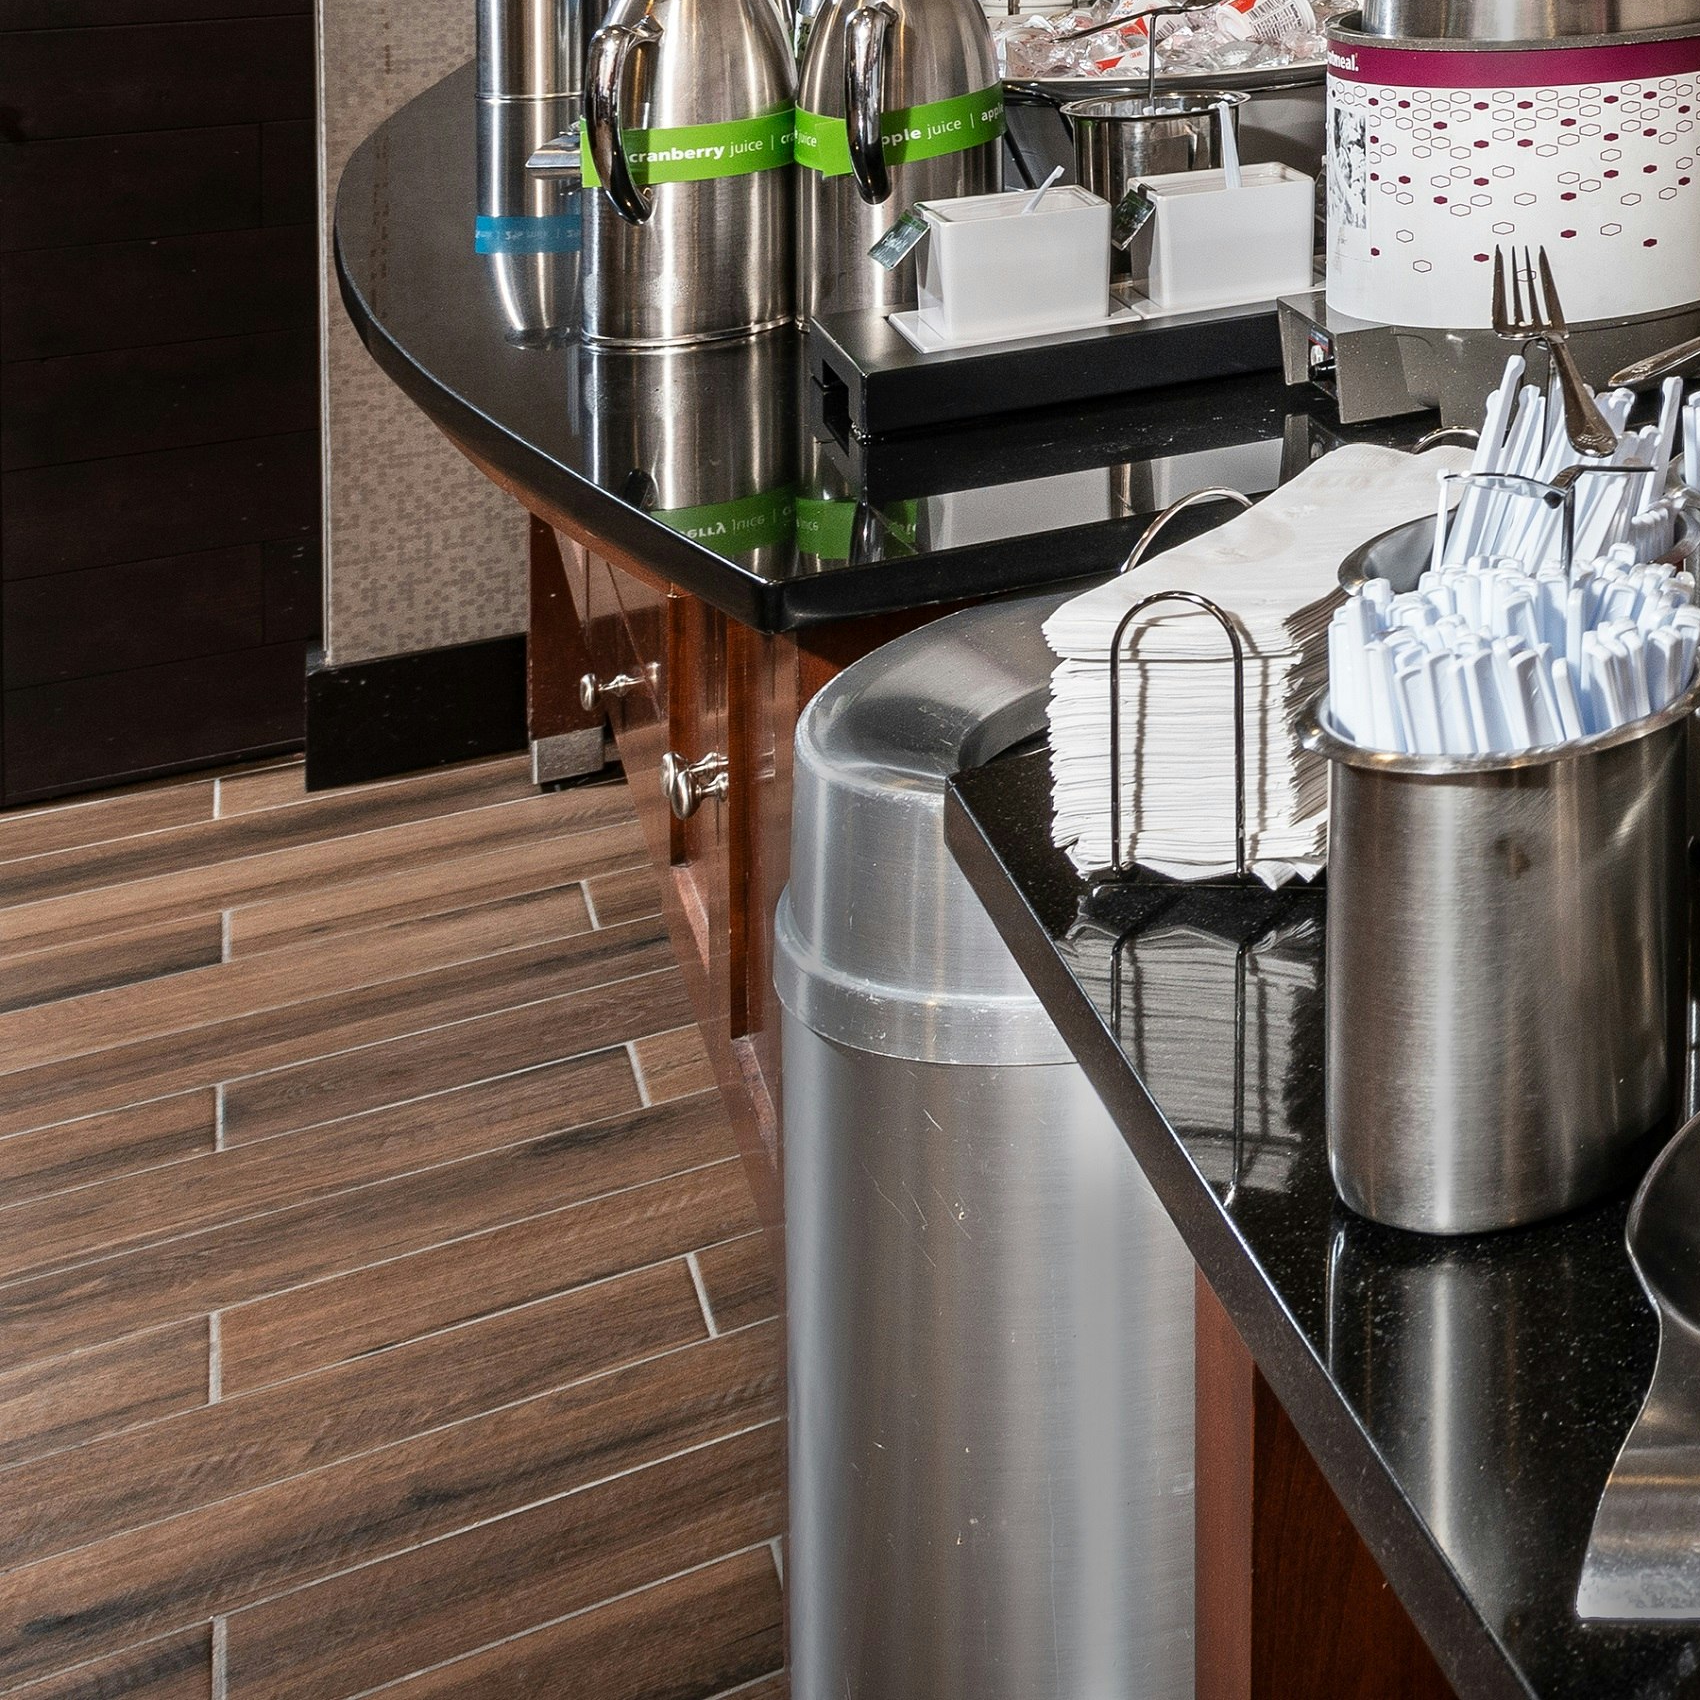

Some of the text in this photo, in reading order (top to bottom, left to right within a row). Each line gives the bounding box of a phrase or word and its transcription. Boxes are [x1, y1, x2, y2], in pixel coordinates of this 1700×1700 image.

[881, 127, 922, 147] pple
[926, 118, 962, 140] juice
[629, 145, 726, 164] cranberry
[729, 137, 764, 158] juice
